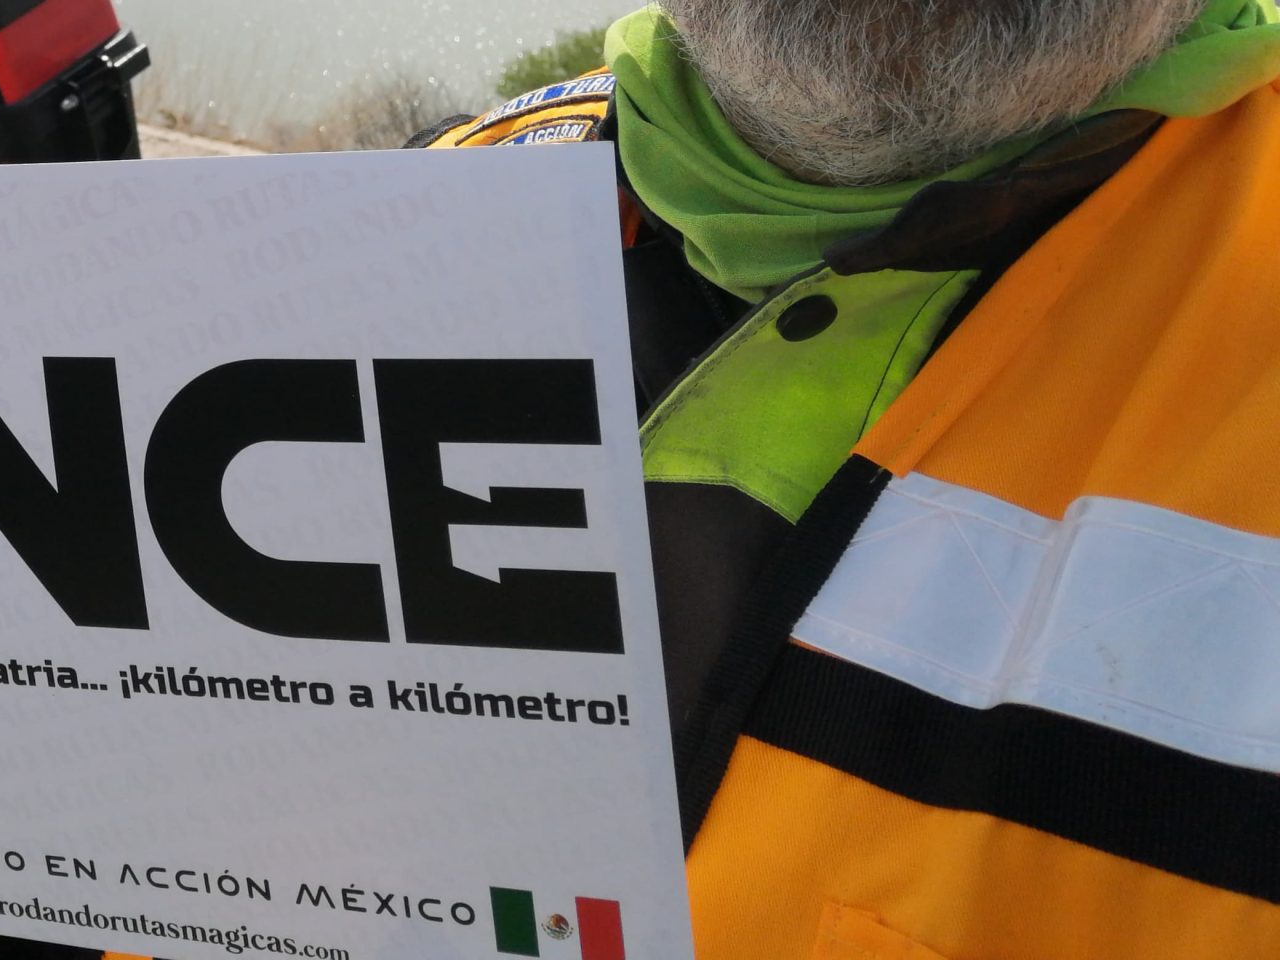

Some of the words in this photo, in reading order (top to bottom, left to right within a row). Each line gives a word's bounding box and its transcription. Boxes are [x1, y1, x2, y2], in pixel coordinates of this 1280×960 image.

[119, 664, 335, 707] ¡kilómetro
[348, 684, 374, 709] a
[387, 679, 630, 727] kilómetro!
[44, 854, 97, 881] EN
[119, 863, 272, 901] ACCIÓN
[295, 883, 476, 927] MÉXICO
